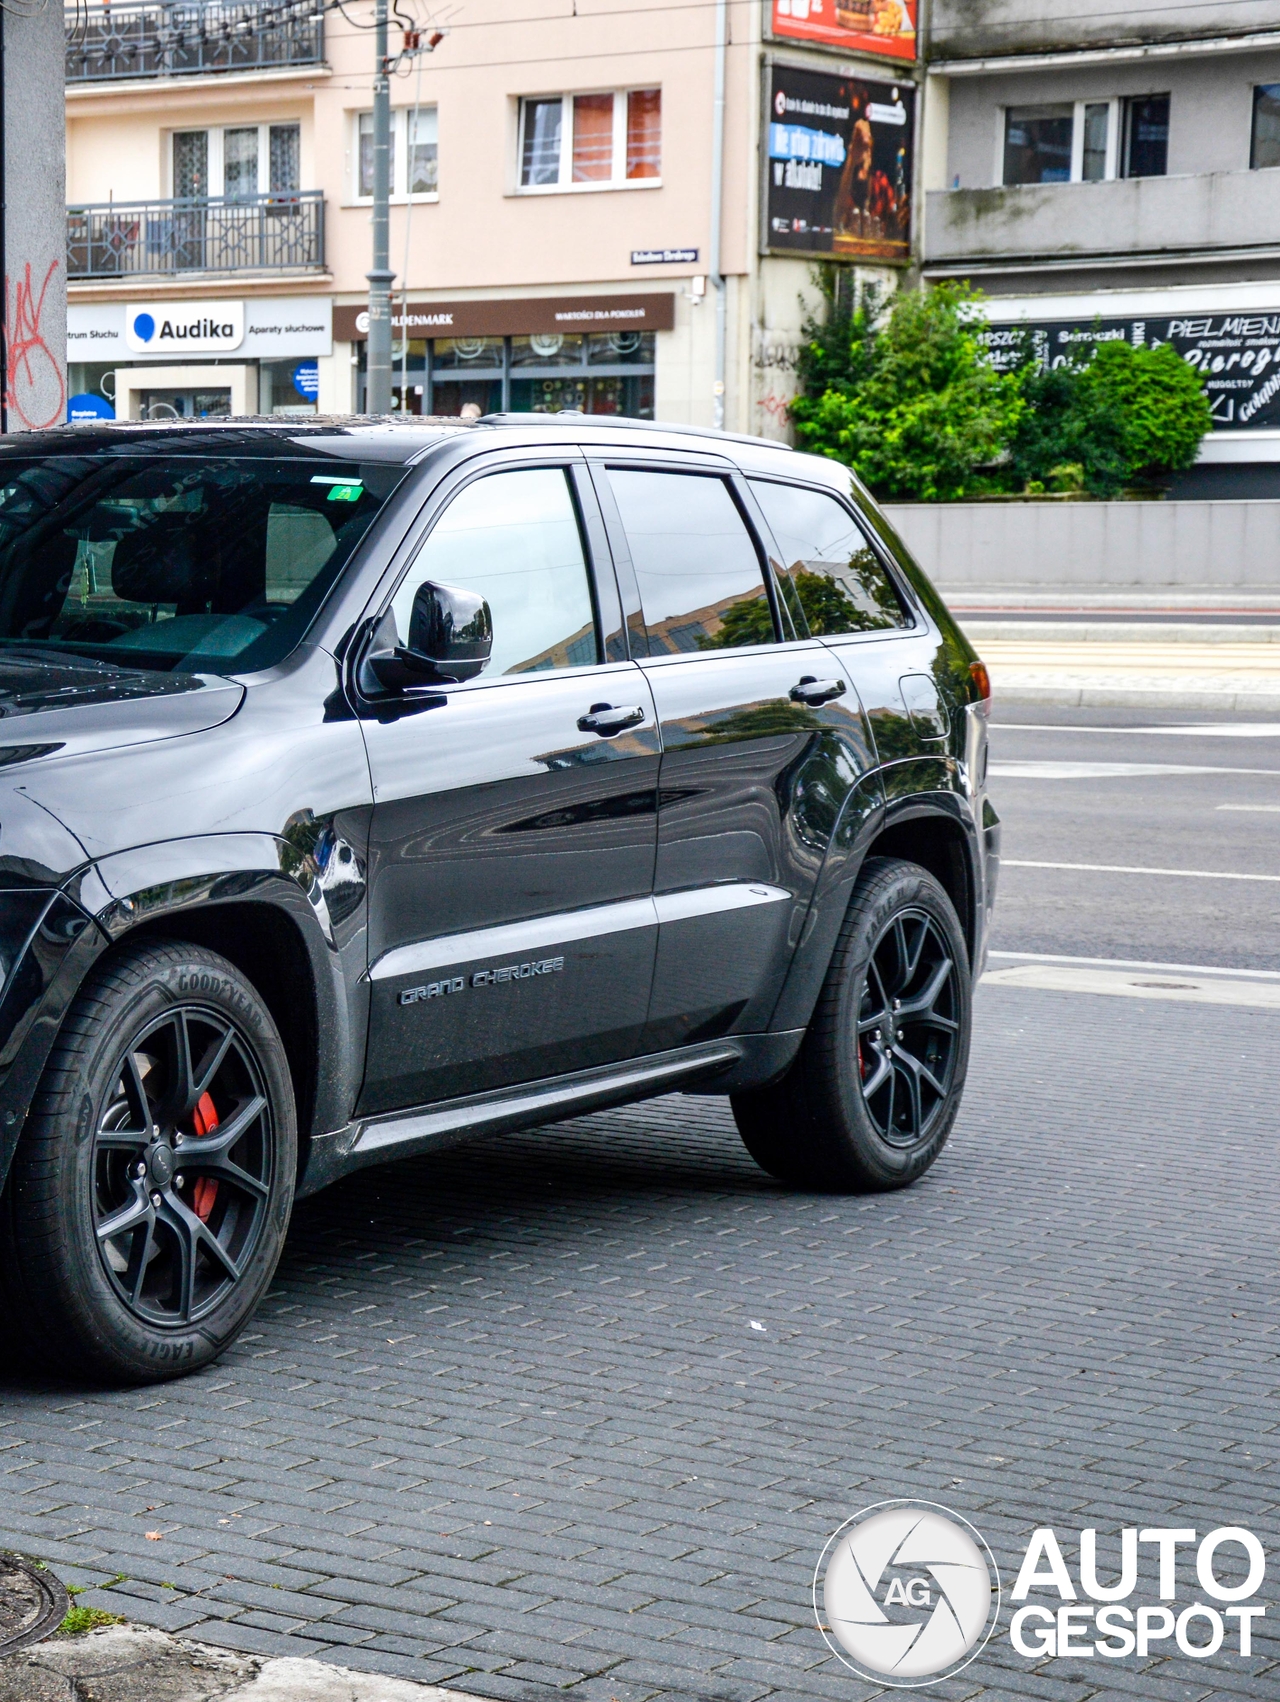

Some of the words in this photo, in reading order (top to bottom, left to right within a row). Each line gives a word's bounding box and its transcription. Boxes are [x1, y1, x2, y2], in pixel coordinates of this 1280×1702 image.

[67, 331, 88, 340] trum
[90, 330, 118, 339] Słuchu
[160, 318, 234, 339] Audika
[248, 326, 282, 336] Aparaty
[284, 323, 326, 333] słuchowe
[399, 976, 465, 1006] GRAND
[472, 956, 565, 988] CHEROKEE
[178, 973, 263, 1028] GOODYEAR
